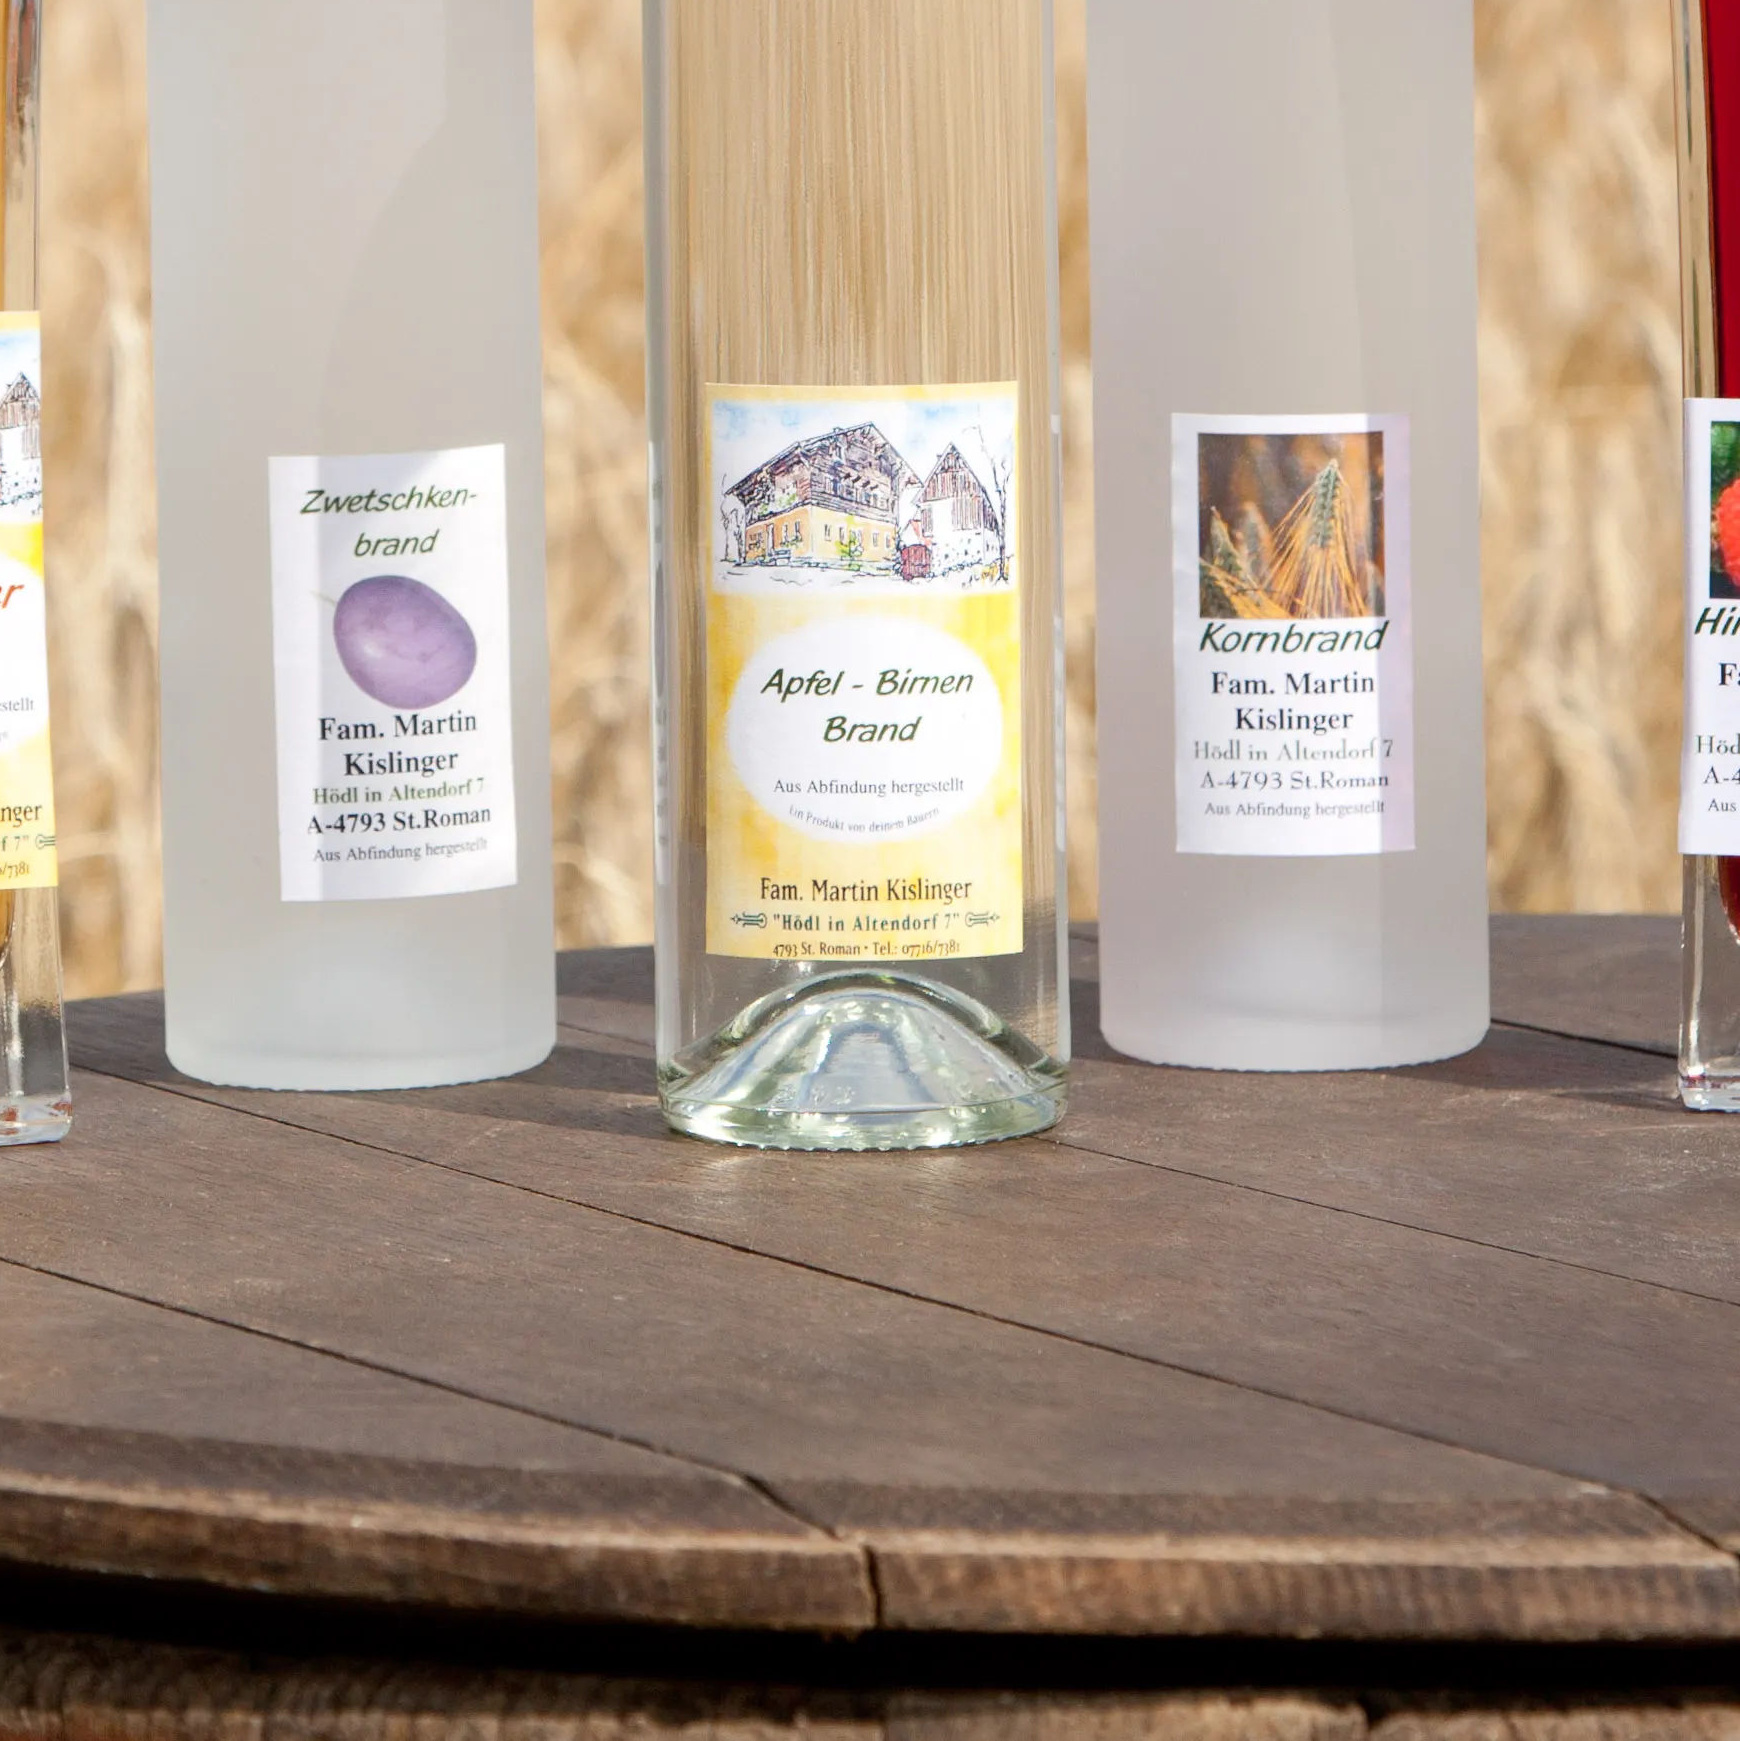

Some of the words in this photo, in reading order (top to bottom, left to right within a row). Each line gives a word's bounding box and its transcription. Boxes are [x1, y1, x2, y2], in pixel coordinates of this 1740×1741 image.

[299, 485, 477, 516] Zwetschken-
[354, 530, 439, 557] brand
[1199, 621, 1389, 653] Kornbrand
[760, 668, 844, 702] Apfel
[875, 669, 974, 695] Birnen
[1211, 672, 1276, 695] Fam.
[1285, 673, 1375, 695] Martin
[319, 716, 384, 741] Fam.
[394, 710, 477, 737] Martin
[823, 716, 921, 743] Brand
[1235, 708, 1354, 735] Kislinger
[1194, 740, 1242, 760] Hödl
[1248, 742, 1268, 760] in
[1276, 738, 1378, 760] Altendorf
[1382, 740, 1393, 757] 7
[344, 750, 459, 777] Kislinger
[313, 787, 359, 805] Hödl
[365, 787, 382, 802] in
[388, 779, 472, 801] Altendorf
[476, 777, 484, 793] 7
[773, 780, 803, 794] Aus
[807, 779, 887, 797] Abfindung
[891, 778, 964, 797] hergestellt
[1201, 772, 1284, 789] A-4793
[1290, 772, 1389, 790] St.Roman
[788, 805, 804, 819] Ein
[806, 811, 845, 831] Produkt
[848, 822, 865, 831] von
[868, 817, 904, 832] deinem
[905, 806, 941, 826] Bauern
[1204, 802, 1231, 815] Aus
[1236, 802, 1311, 818] Abfindung
[1315, 801, 1384, 818] hergestellt
[1708, 799, 1737, 812] Aus
[307, 812, 386, 834] A-4793
[393, 806, 492, 831] St.Roman
[313, 848, 342, 862] Aus
[346, 844, 422, 862] Abfindung
[425, 836, 488, 859] hergestellt
[760, 878, 804, 900] Fam.
[811, 879, 879, 901] Martin
[886, 877, 972, 905] Kislinger
[773, 913, 820, 931] "Hödl
[828, 914, 845, 931] in
[852, 913, 938, 931] Altendorf
[772, 943, 798, 958] 4793
[801, 943, 816, 955] St.
[819, 943, 860, 955] Roman
[872, 943, 897, 956] Tel.:
